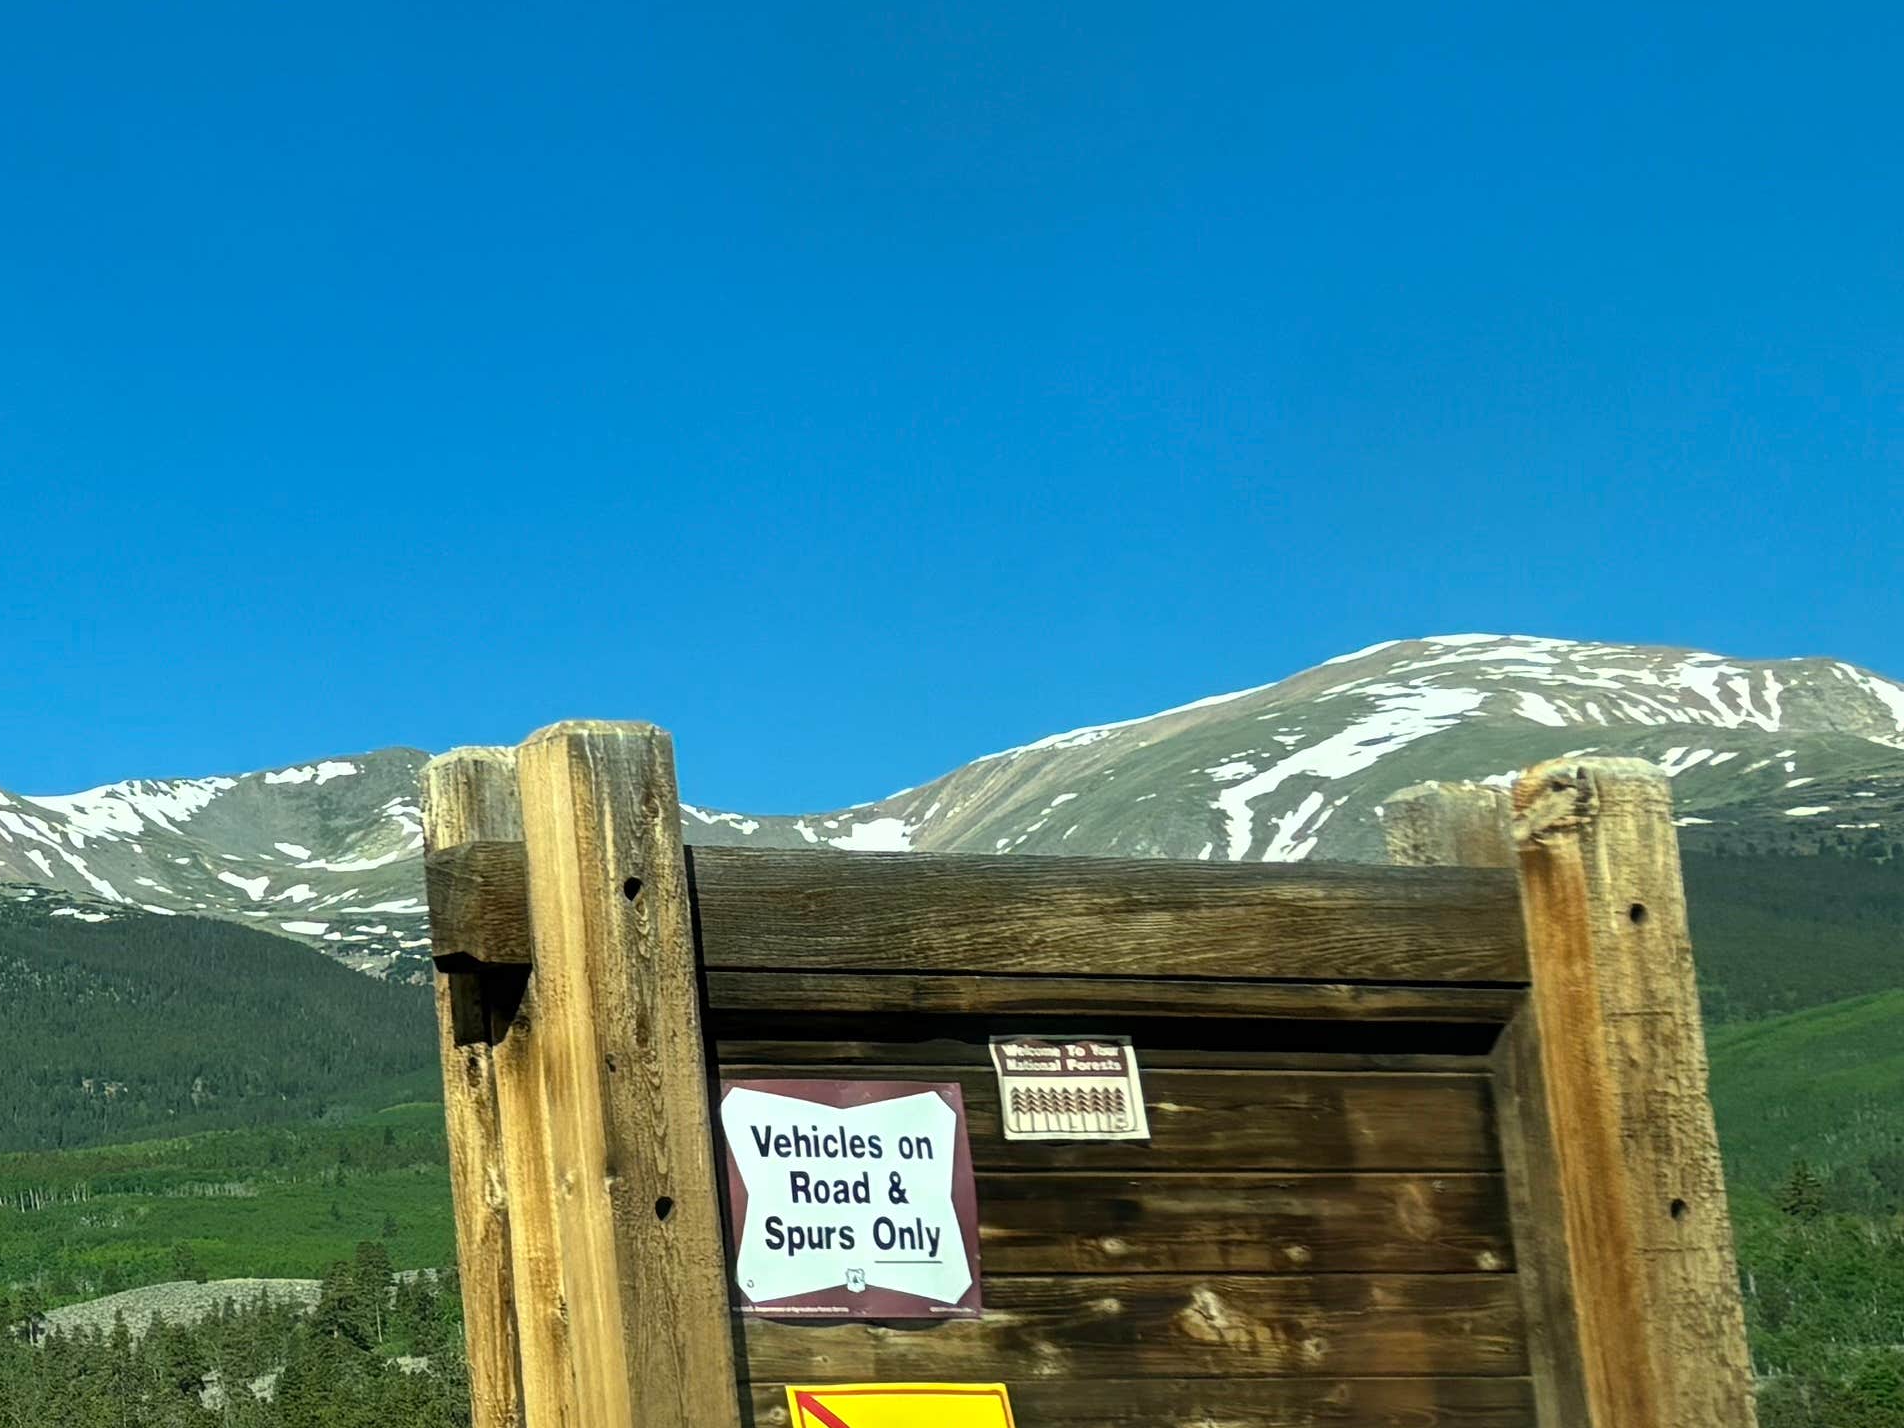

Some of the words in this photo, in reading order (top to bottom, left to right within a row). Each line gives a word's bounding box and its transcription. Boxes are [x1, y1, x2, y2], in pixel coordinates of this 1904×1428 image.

[1006, 1059, 1062, 1071] National
[1066, 1059, 1122, 1071] Forests
[1065, 1045, 1085, 1057] To
[750, 1125, 883, 1159] Vehicles
[898, 1136, 933, 1160] on
[790, 1171, 871, 1204] Road
[888, 1171, 909, 1205] &
[765, 1216, 855, 1257] Spurs
[873, 1216, 940, 1258] Only
